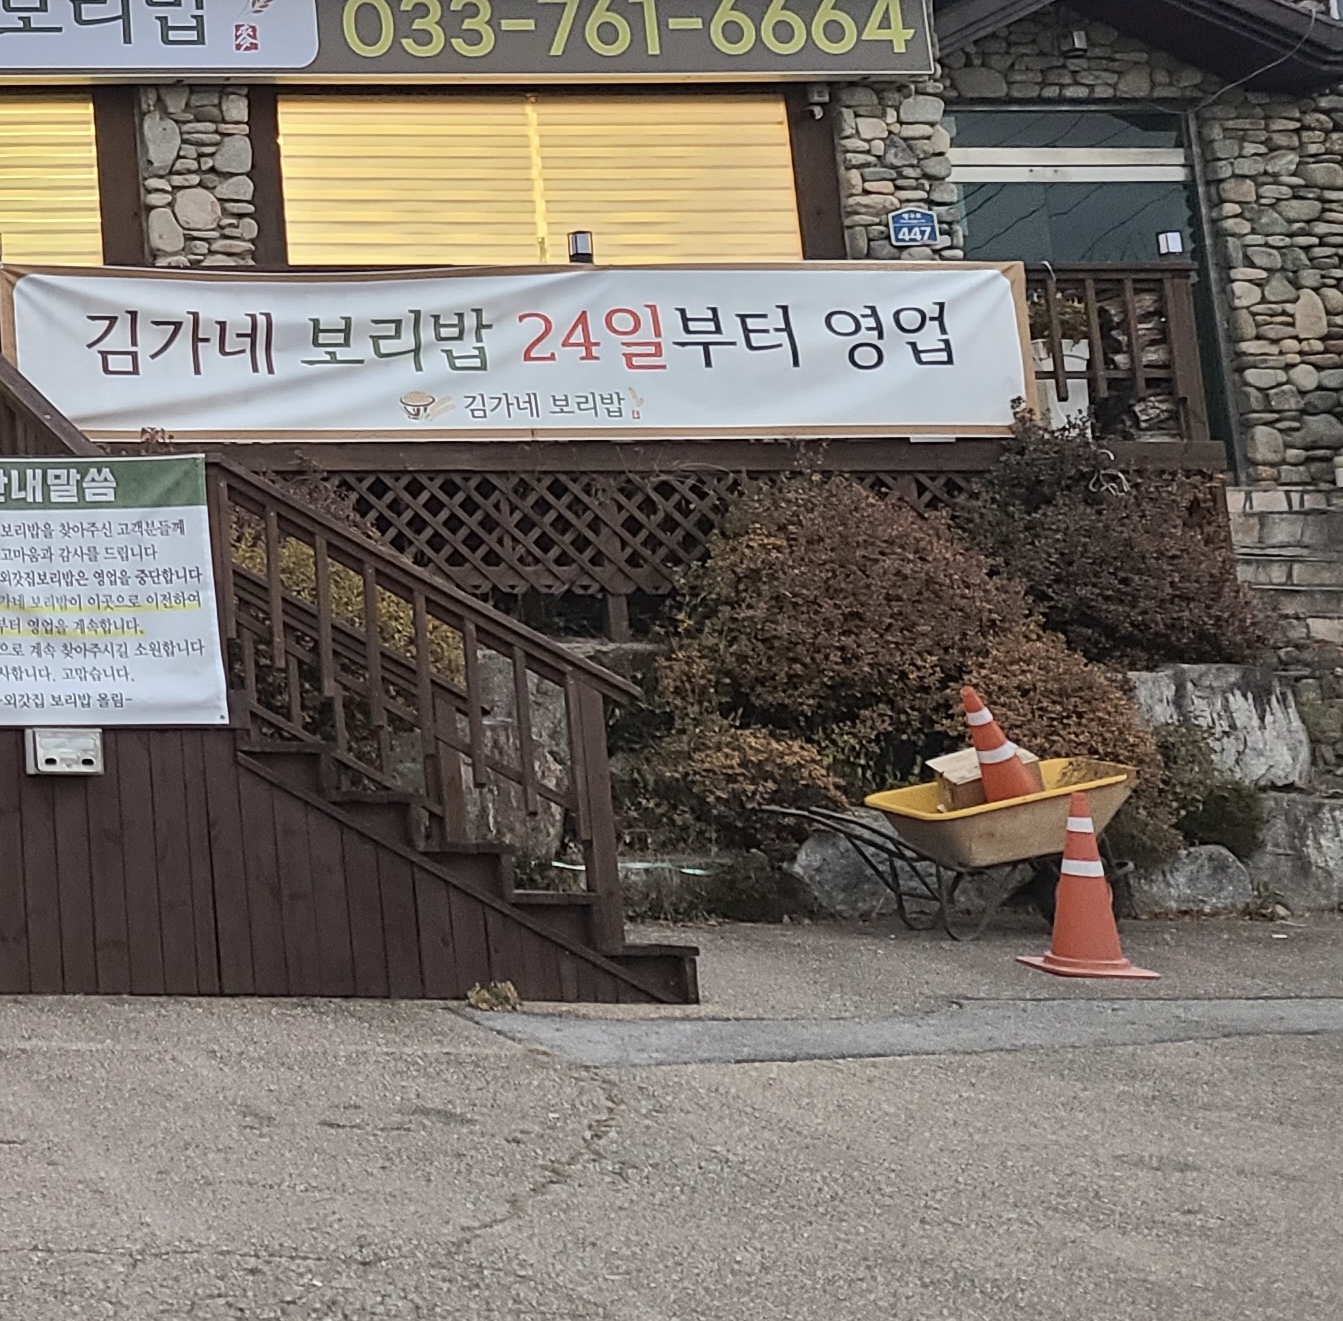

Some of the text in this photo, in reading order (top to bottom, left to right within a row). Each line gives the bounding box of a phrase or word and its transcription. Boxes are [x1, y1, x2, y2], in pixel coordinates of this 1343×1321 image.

[897, 226, 932, 242] 447
[85, 301, 956, 377] 김가네 보리밥 24일부터 영업
[463, 391, 626, 419] 김가네 보리밥
[0, 521, 55, 540] 보리밥을
[59, 520, 113, 539] 찾아주신
[117, 518, 186, 537] 고객분들께
[0, 545, 55, 564] 고마움과
[59, 545, 100, 563] 감사를
[103, 543, 158, 562] 드립니다
[0, 568, 89, 588] 외갓집보리밥은
[93, 567, 132, 586] 영업을
[135, 565, 203, 586] 중단합니다
[30, 593, 82, 611] 보리밥이
[87, 592, 142, 611] 이곳으로
[145, 590, 202, 609] 이전하여
[27, 618, 69, 635] 영업을
[73, 616, 145, 635] 계속합니다.
[30, 641, 57, 659] 계속
[61, 641, 130, 660] 찾아주시길
[133, 638, 206, 658] 소원합니다
[62, 665, 136, 683] 고맙습니다.
[50, 692, 92, 709] 보리밥
[96, 692, 134, 709] 올림-
